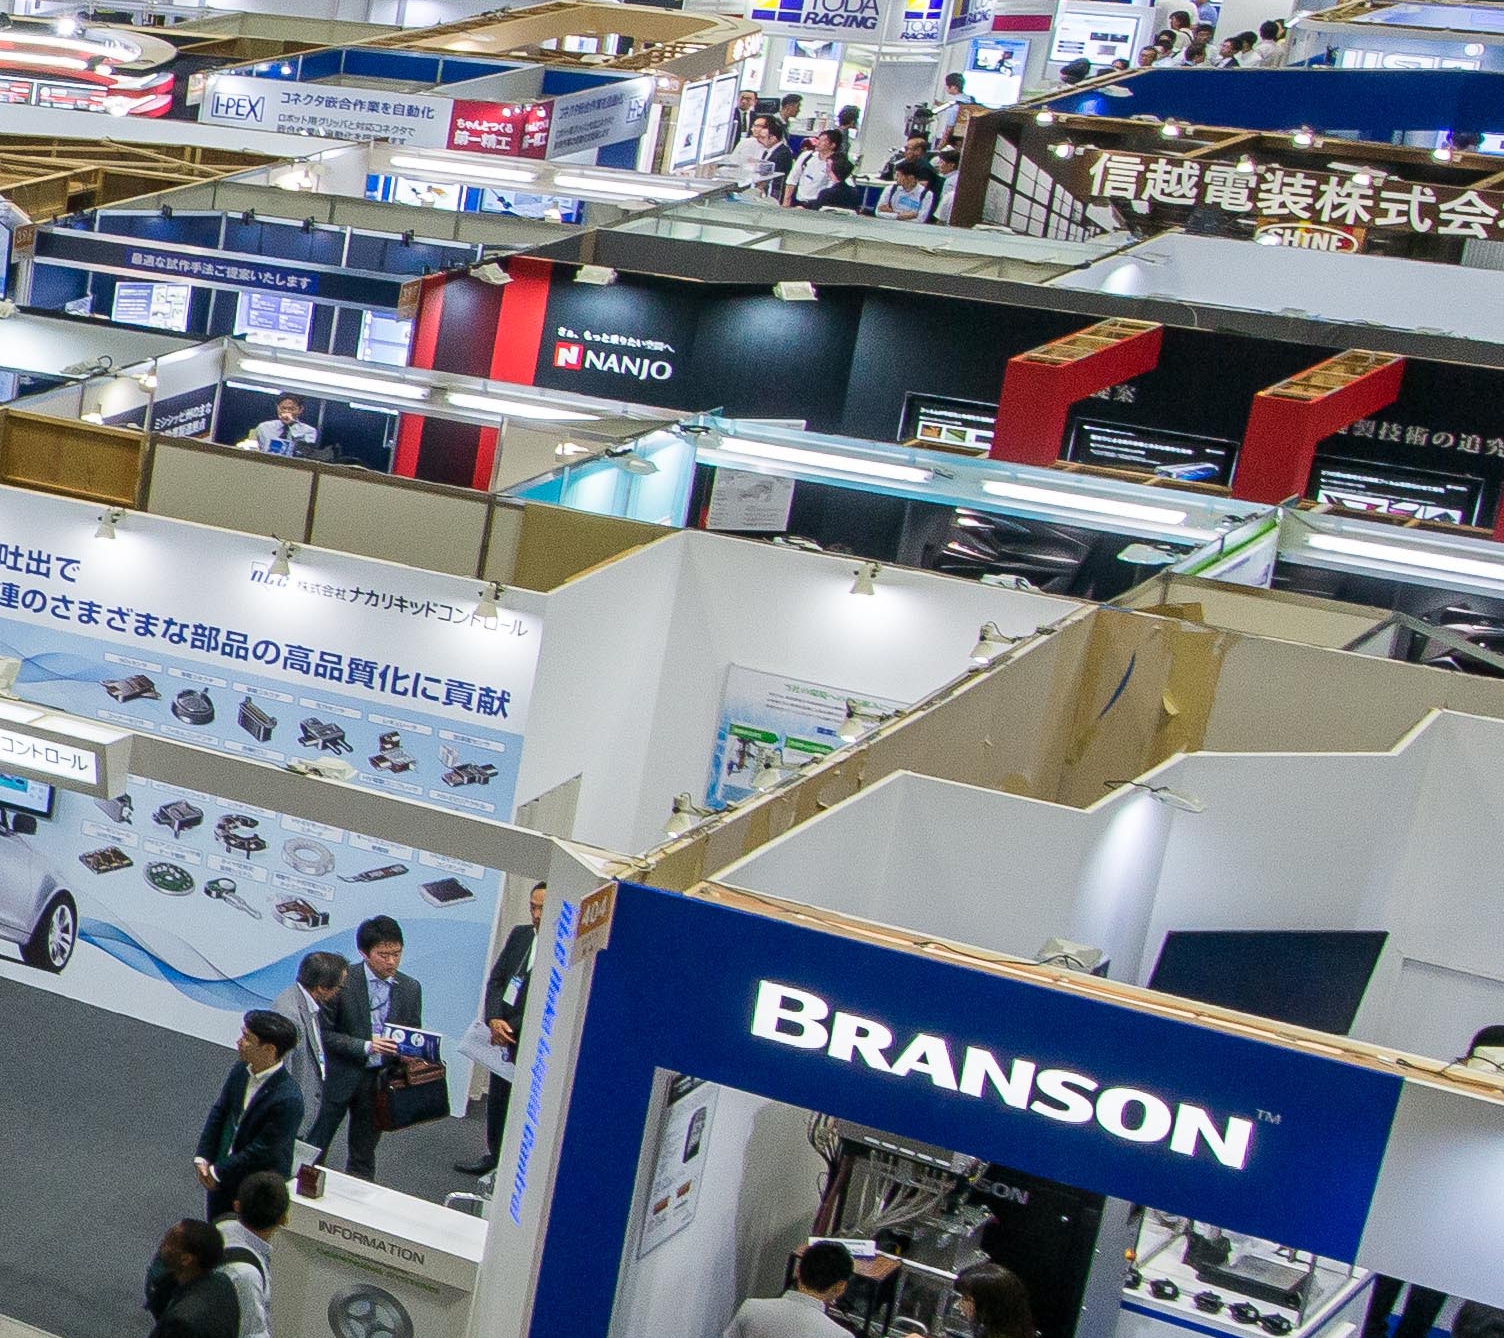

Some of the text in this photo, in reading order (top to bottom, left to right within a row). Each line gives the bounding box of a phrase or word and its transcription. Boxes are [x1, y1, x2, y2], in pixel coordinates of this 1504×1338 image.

[803, 13, 878, 35] RACING
[903, 20, 938, 36] TODA
[213, 95, 263, 122] I-PEX
[1088, 155, 1504, 240] 信越電装株式会
[130, 250, 312, 289] 最適な試作手法ご提案いたします
[583, 348, 674, 382] NANJO
[297, 579, 529, 638] 株式会社ナカリキッドコントロール
[751, 979, 1254, 1170] BRANSON
[318, 1220, 426, 1266] INFORMATION
